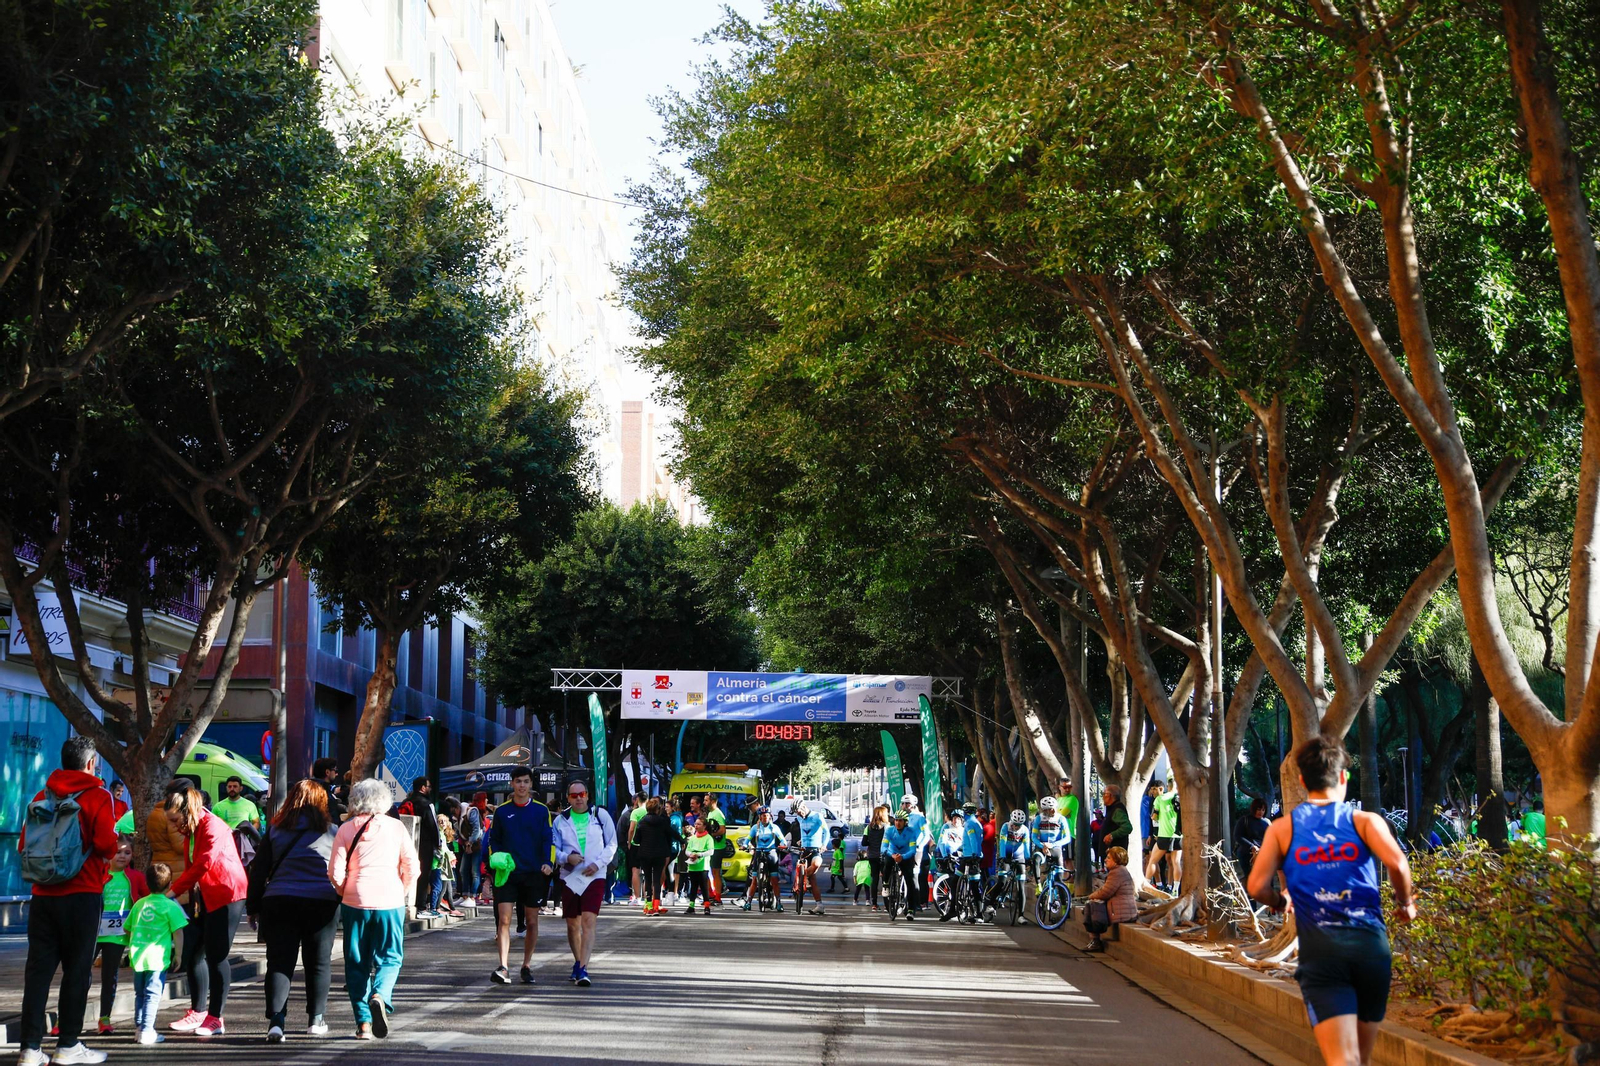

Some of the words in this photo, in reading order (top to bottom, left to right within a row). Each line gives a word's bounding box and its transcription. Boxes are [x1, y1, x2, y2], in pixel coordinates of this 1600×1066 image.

[716, 677, 767, 689] Almería
[789, 678, 839, 690] marcha
[716, 692, 758, 703] contra
[761, 692, 774, 703] el
[777, 692, 823, 704] cáncer
[1294, 841, 1359, 865] GALO
[1316, 862, 1341, 870] SPORT
